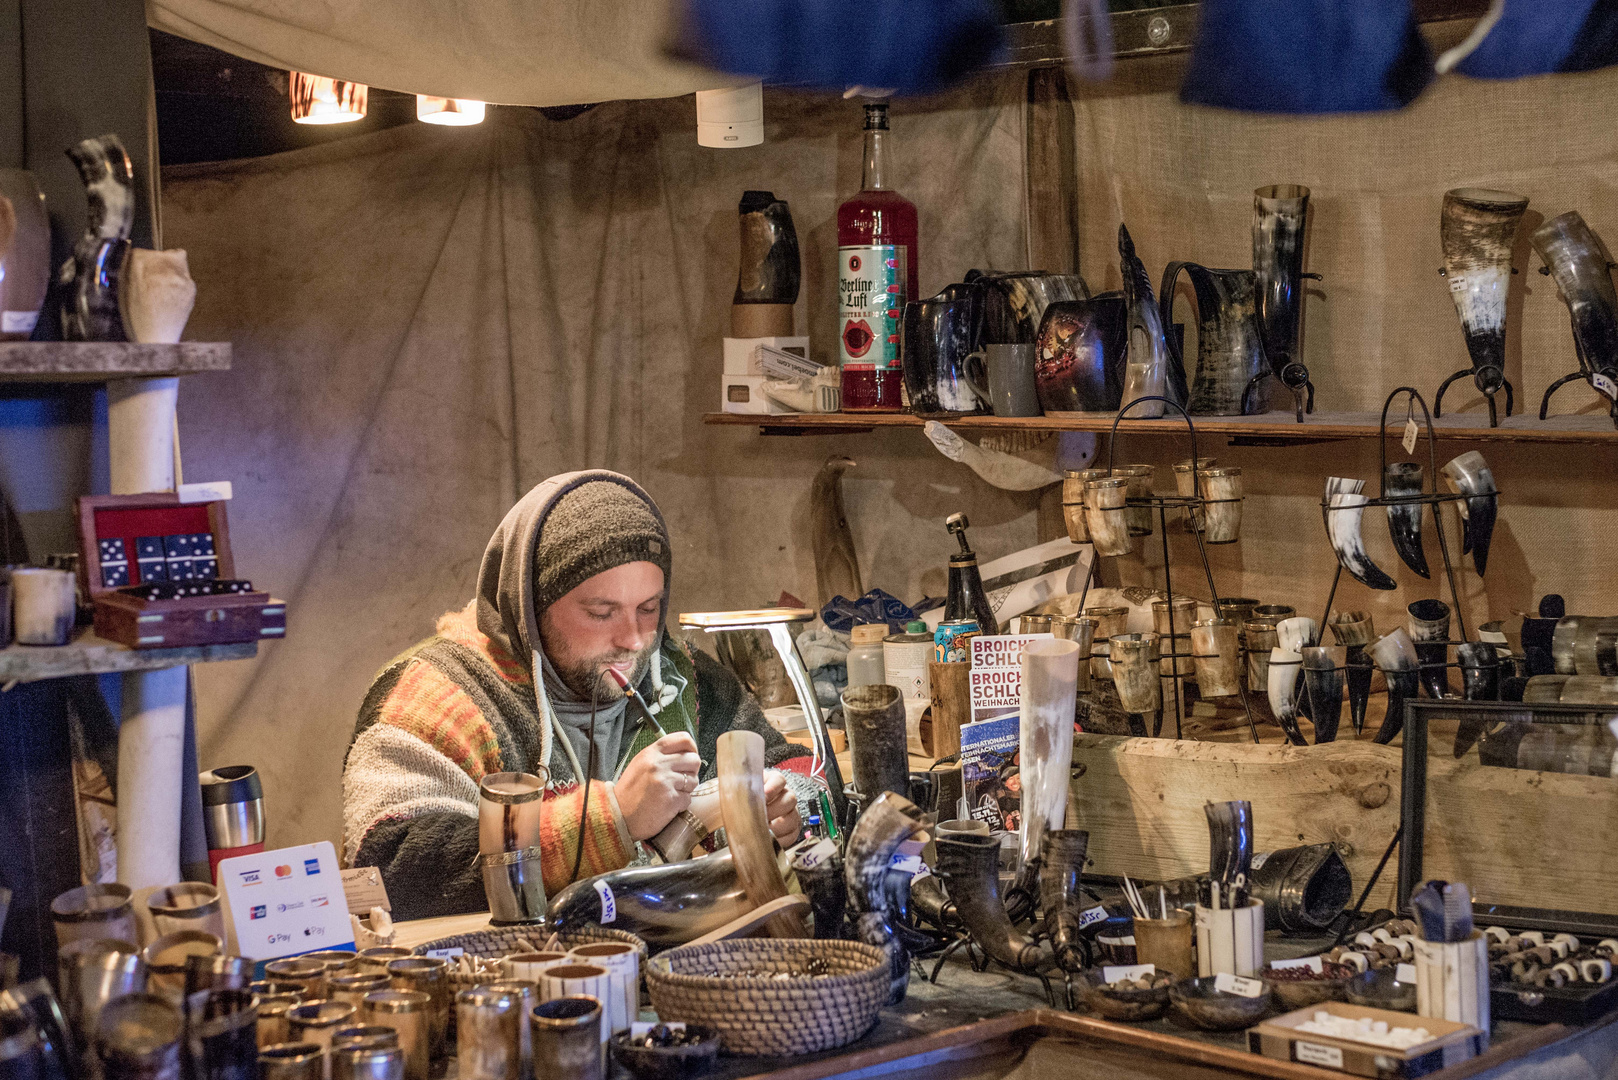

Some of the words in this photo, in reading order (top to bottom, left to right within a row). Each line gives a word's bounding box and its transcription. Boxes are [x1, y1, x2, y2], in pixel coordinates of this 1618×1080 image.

[846, 292, 868, 310] Luft
[974, 640, 1035, 652] BROICH
[973, 697, 1020, 707] WEIHNACH
[243, 874, 260, 883] VISA
[310, 926, 326, 936] Pay
[277, 933, 291, 943] Pay
